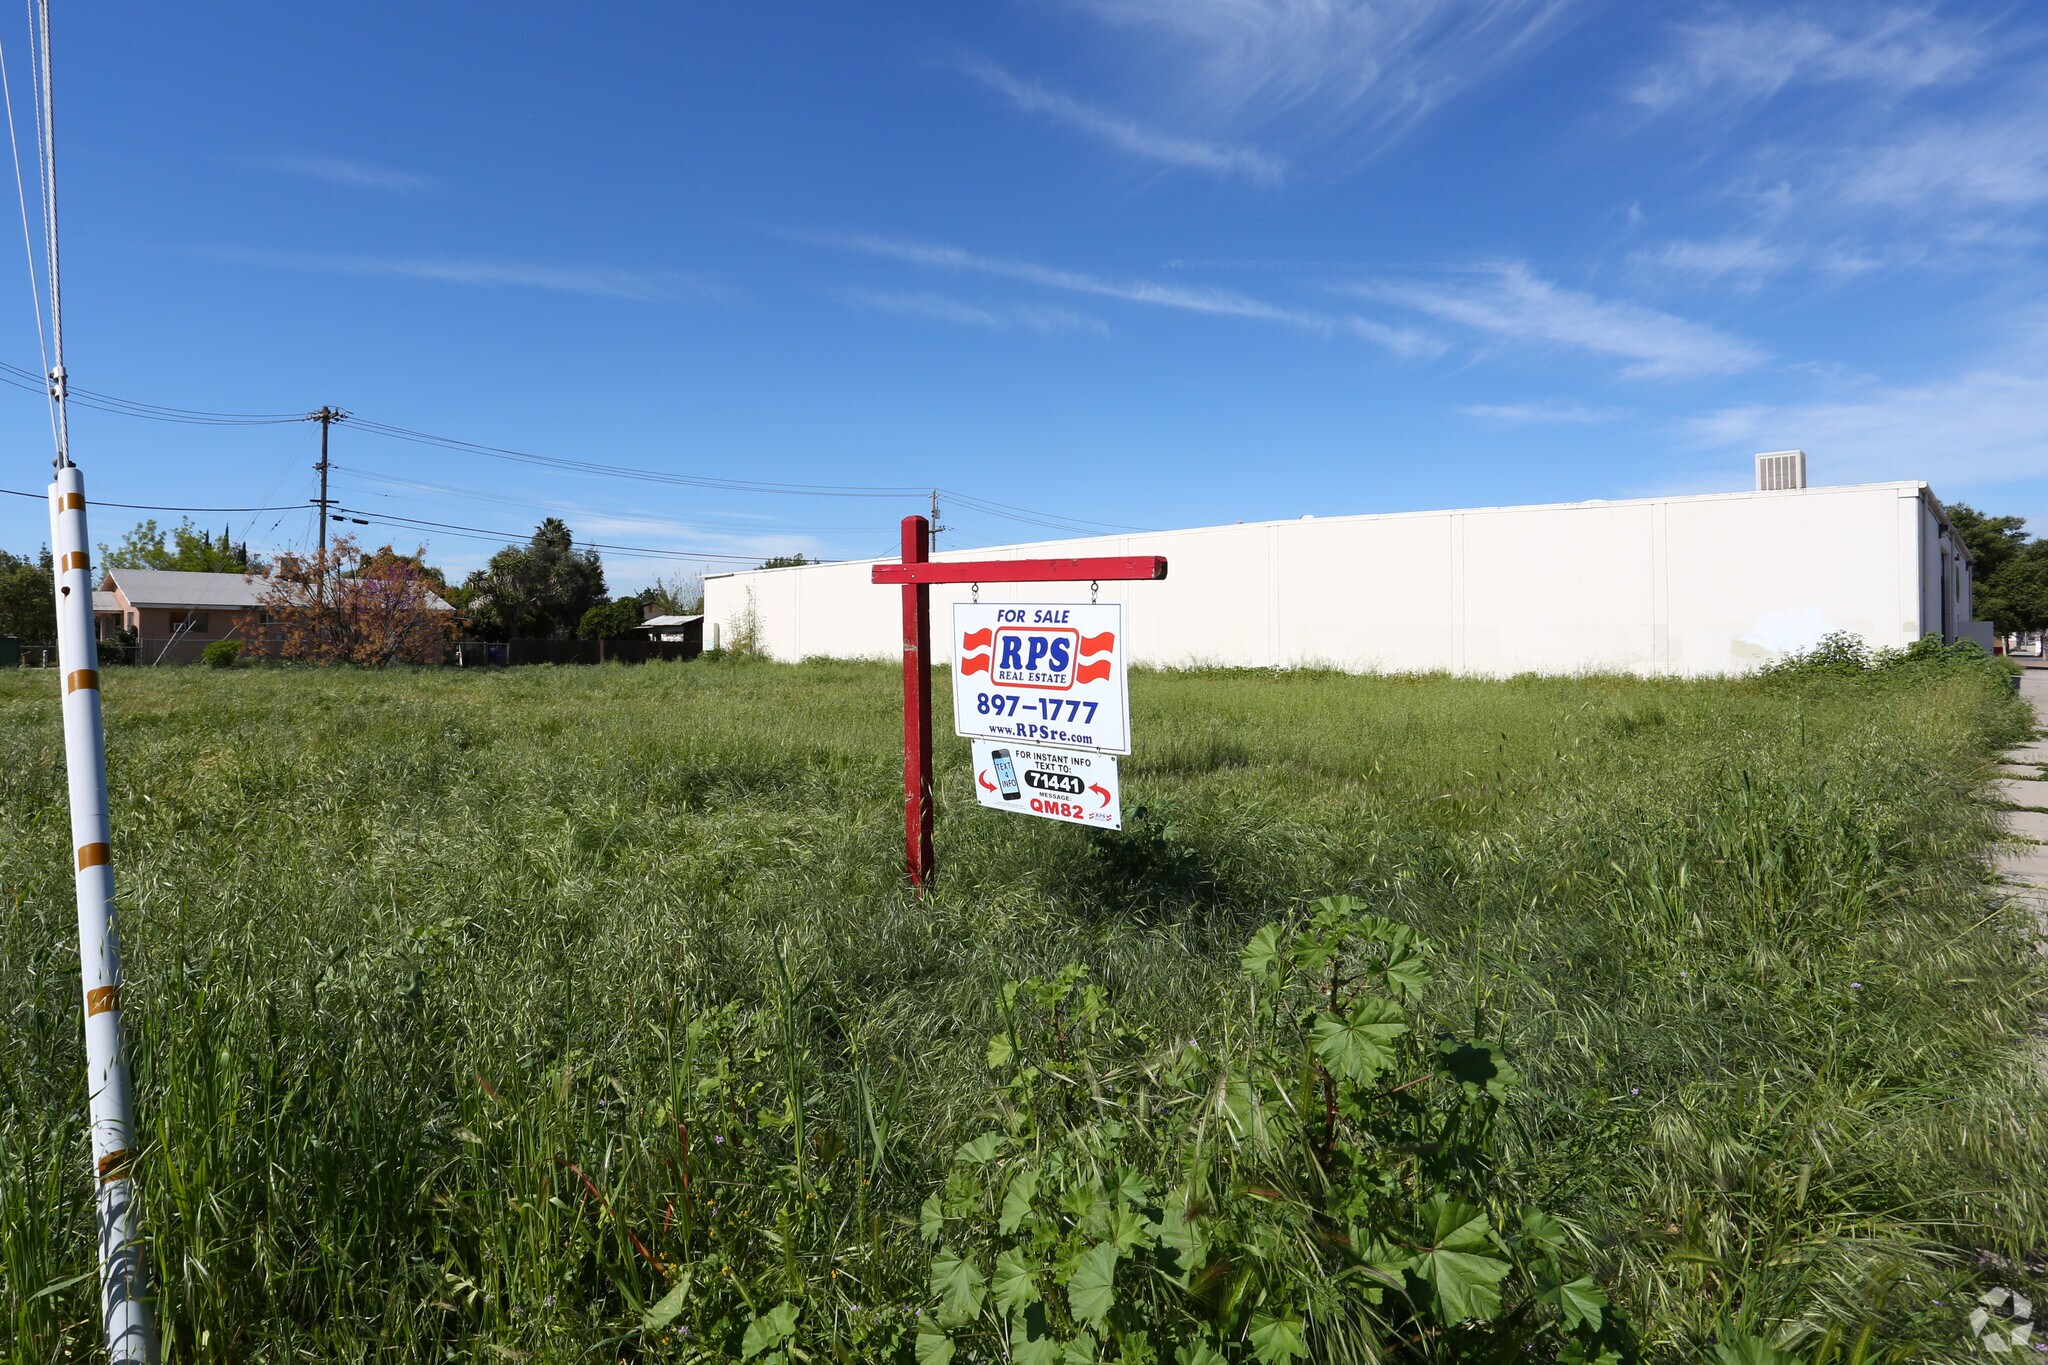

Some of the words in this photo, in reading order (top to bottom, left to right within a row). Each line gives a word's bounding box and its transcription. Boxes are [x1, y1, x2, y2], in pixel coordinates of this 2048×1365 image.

[997, 609, 1026, 623] FOR
[1033, 609, 1070, 624] SALE
[999, 635, 1071, 672] RPS
[999, 671, 1025, 681] REAL
[1028, 673, 1067, 684] ESTATE
[976, 692, 1099, 725] 897-1777
[989, 722, 1093, 745] www.RPSre.com
[996, 761, 1012, 770] TEXT
[1015, 750, 1032, 759] FOR
[1033, 753, 1068, 764] INSTANT
[1071, 757, 1092, 767] INFO
[1035, 761, 1055, 771] TEXT
[1059, 764, 1072, 774] TO:
[1002, 779, 1017, 788] INFO
[1030, 772, 1080, 793] 71441
[1039, 791, 1072, 801] MESSAGE:
[1030, 798, 1084, 819] QM82
